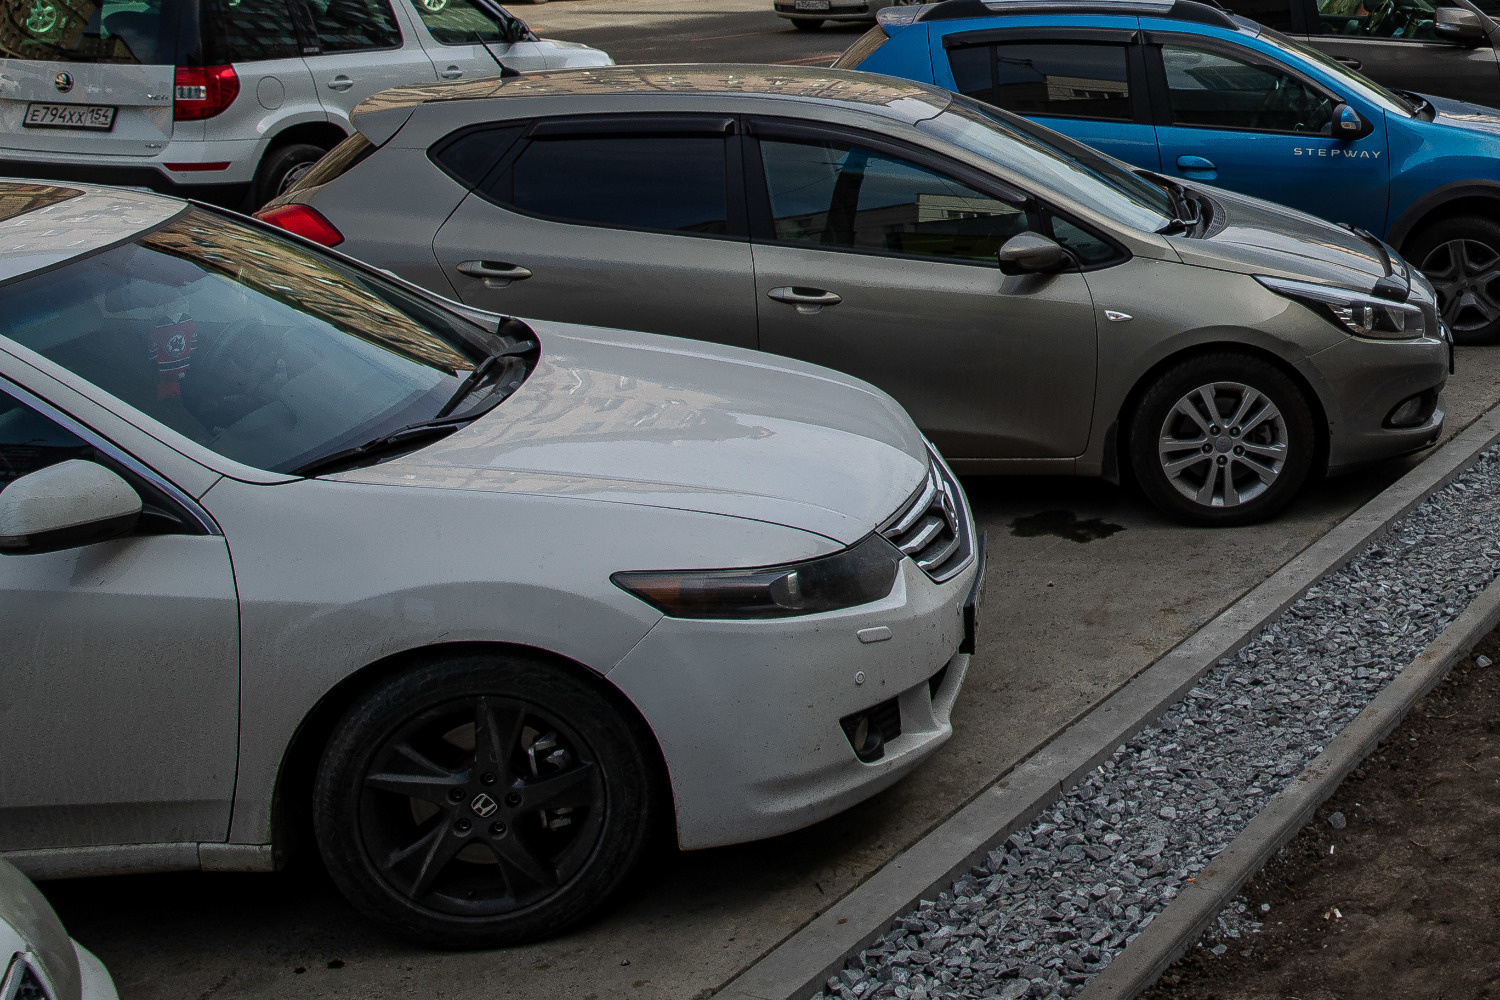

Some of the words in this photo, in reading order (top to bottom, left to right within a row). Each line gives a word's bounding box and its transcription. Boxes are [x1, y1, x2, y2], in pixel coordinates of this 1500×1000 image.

[30, 106, 86, 124] Е794ХХ
[88, 108, 111, 122] 154
[1293, 147, 1382, 159] STEPWAY
